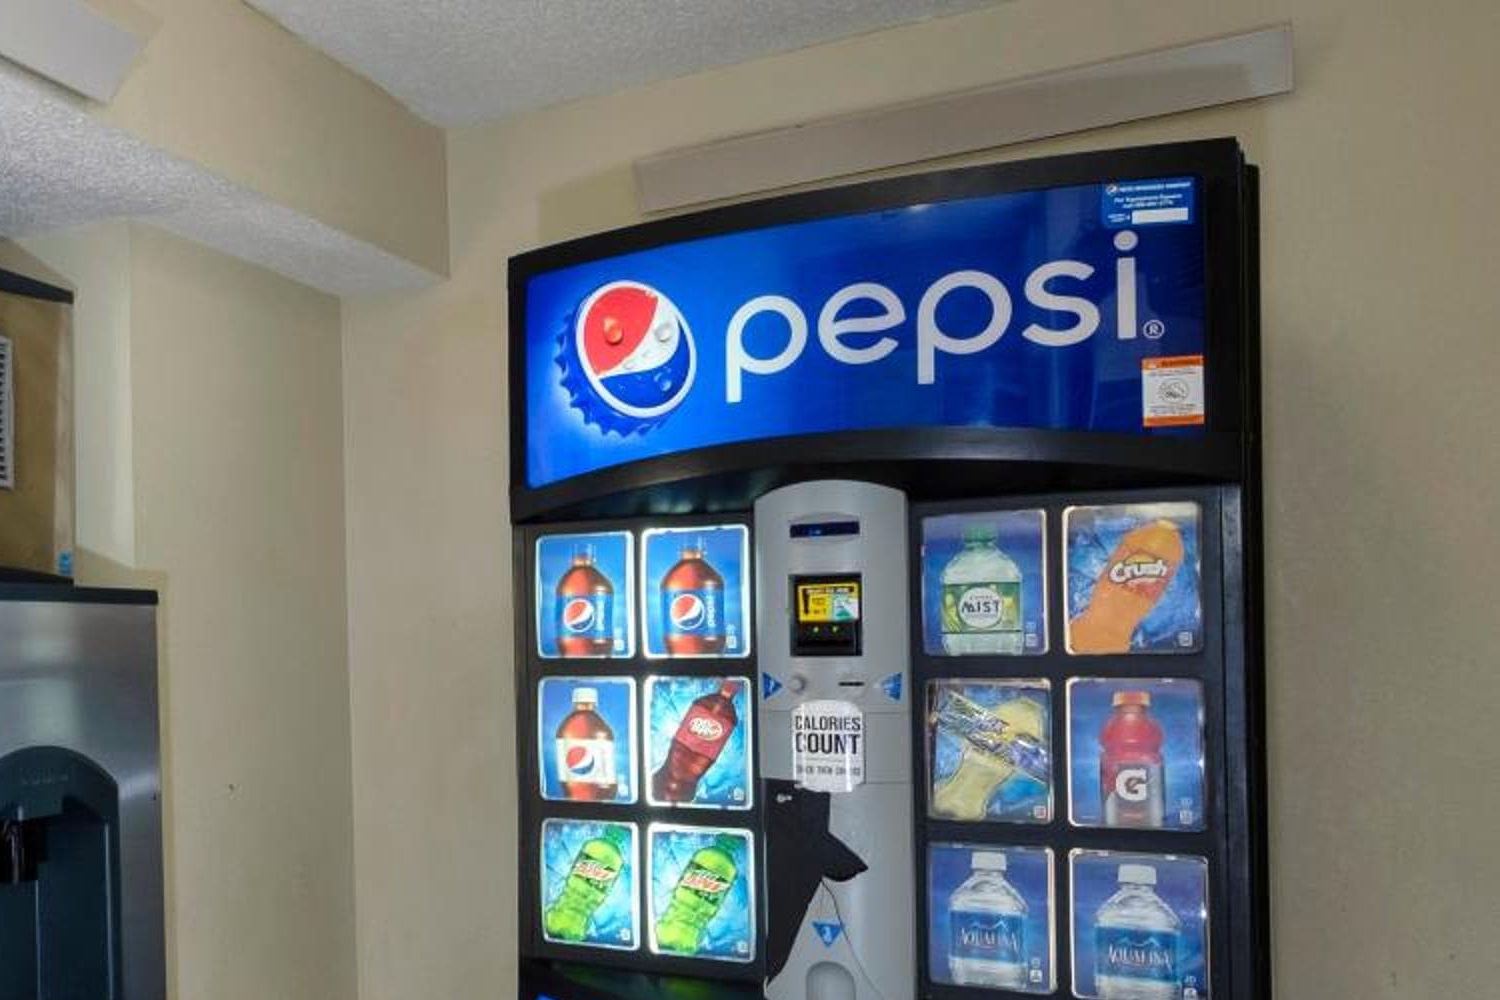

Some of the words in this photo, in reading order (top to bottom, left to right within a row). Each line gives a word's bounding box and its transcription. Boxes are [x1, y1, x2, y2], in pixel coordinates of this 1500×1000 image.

[725, 229, 1137, 403] pepsi
[1110, 558, 1168, 584] Crush
[795, 715, 861, 731] CALORIES
[795, 732, 861, 755] COUNT
[1114, 768, 1148, 800] G
